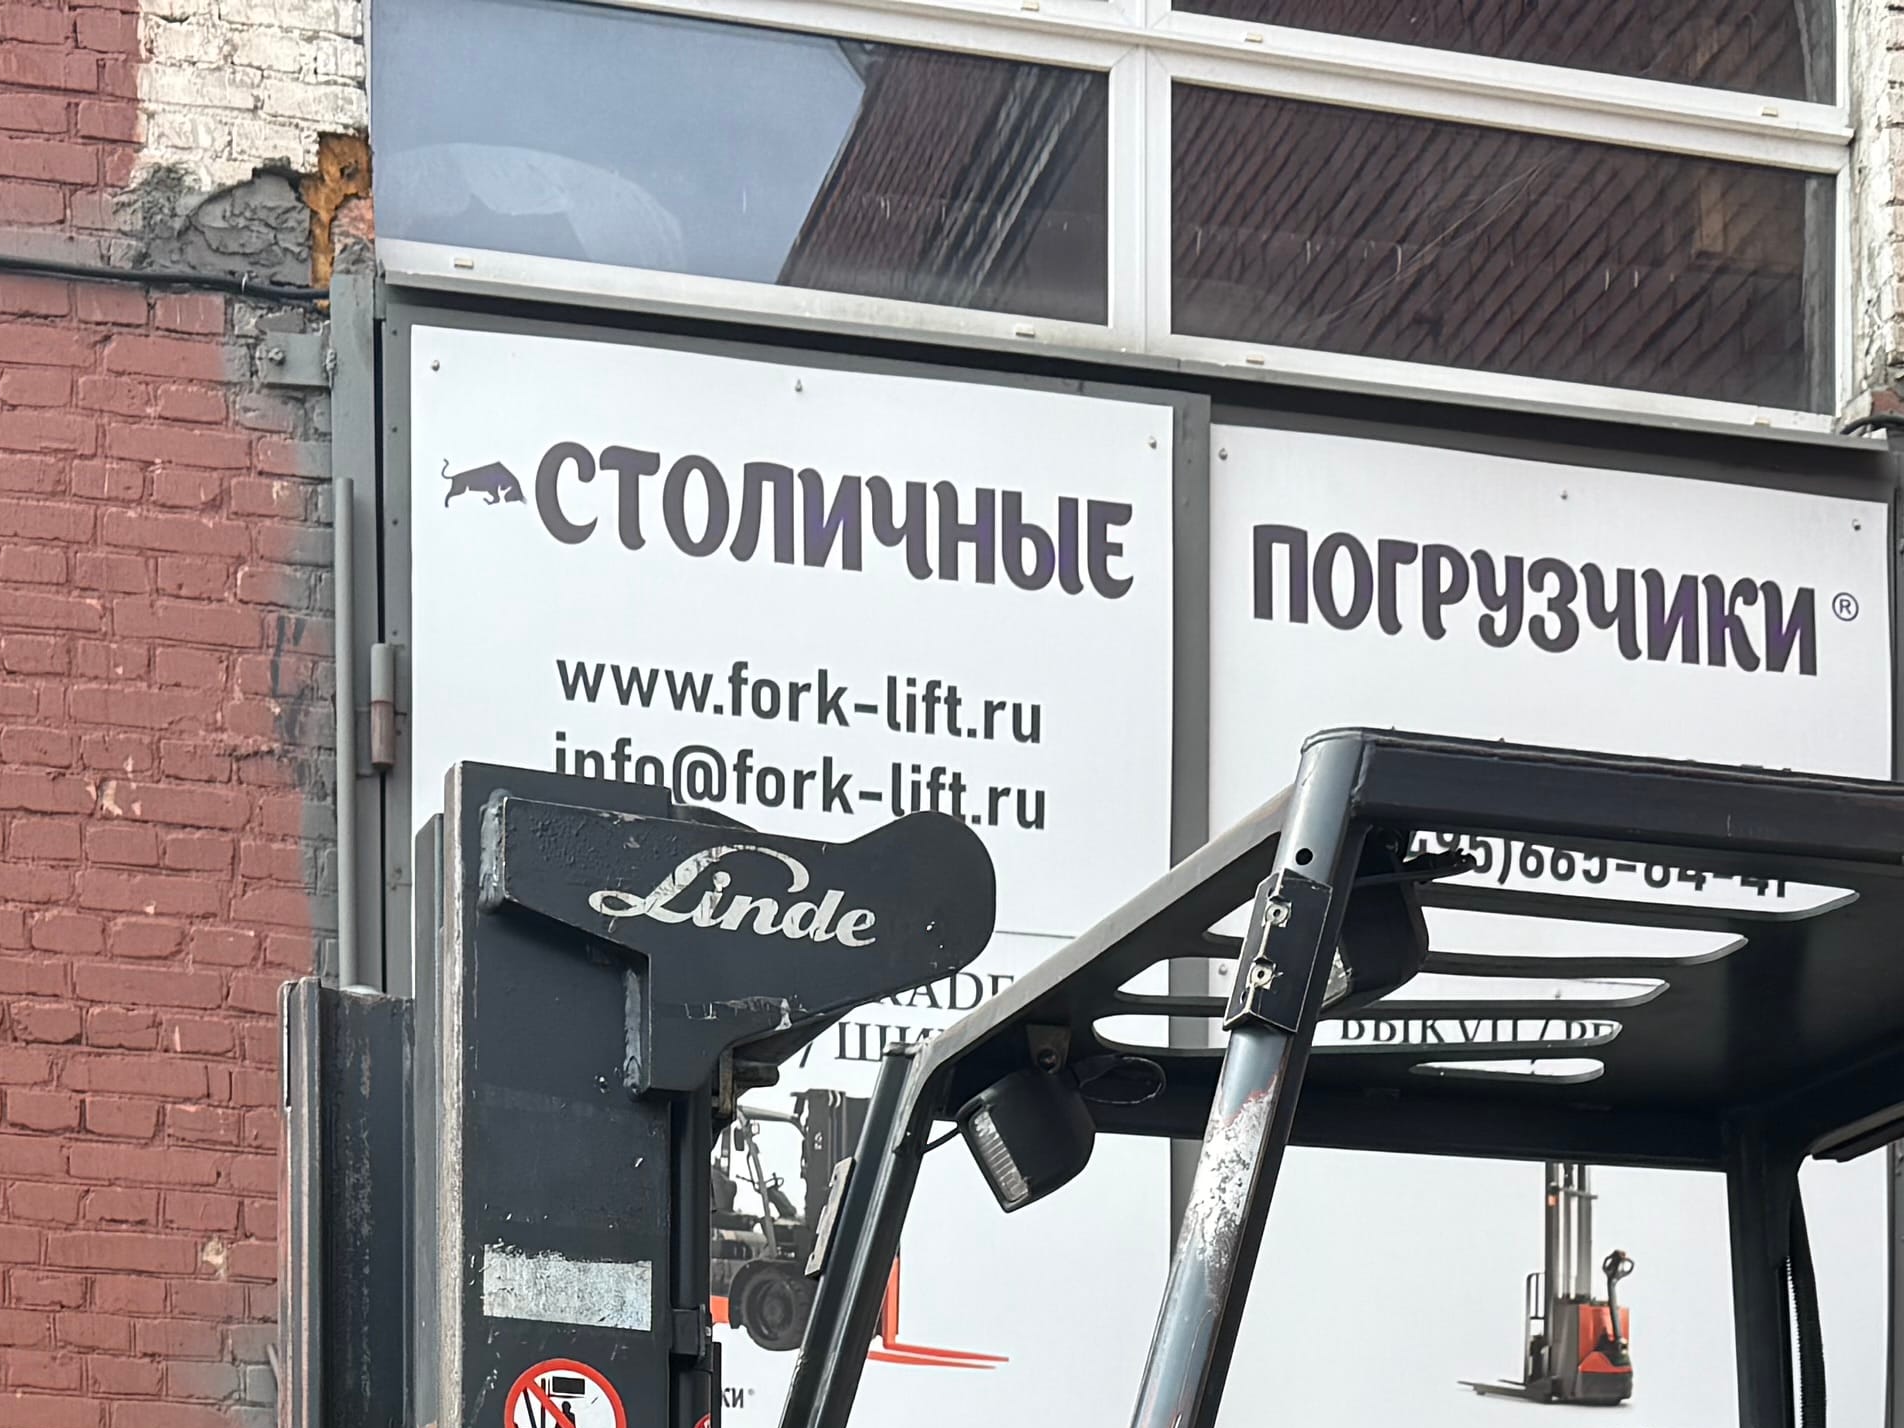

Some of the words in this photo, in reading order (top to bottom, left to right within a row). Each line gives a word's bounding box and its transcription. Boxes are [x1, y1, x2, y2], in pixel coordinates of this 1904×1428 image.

[535, 441, 1134, 600] СТОЛИЧНЫЕ
[1252, 523, 1818, 677] ПОГРУЗЧИКИ
[555, 659, 1042, 745] www.fork-lift.ru
[555, 731, 1046, 831] info@fork-lift.ru
[588, 844, 876, 948] Linde
